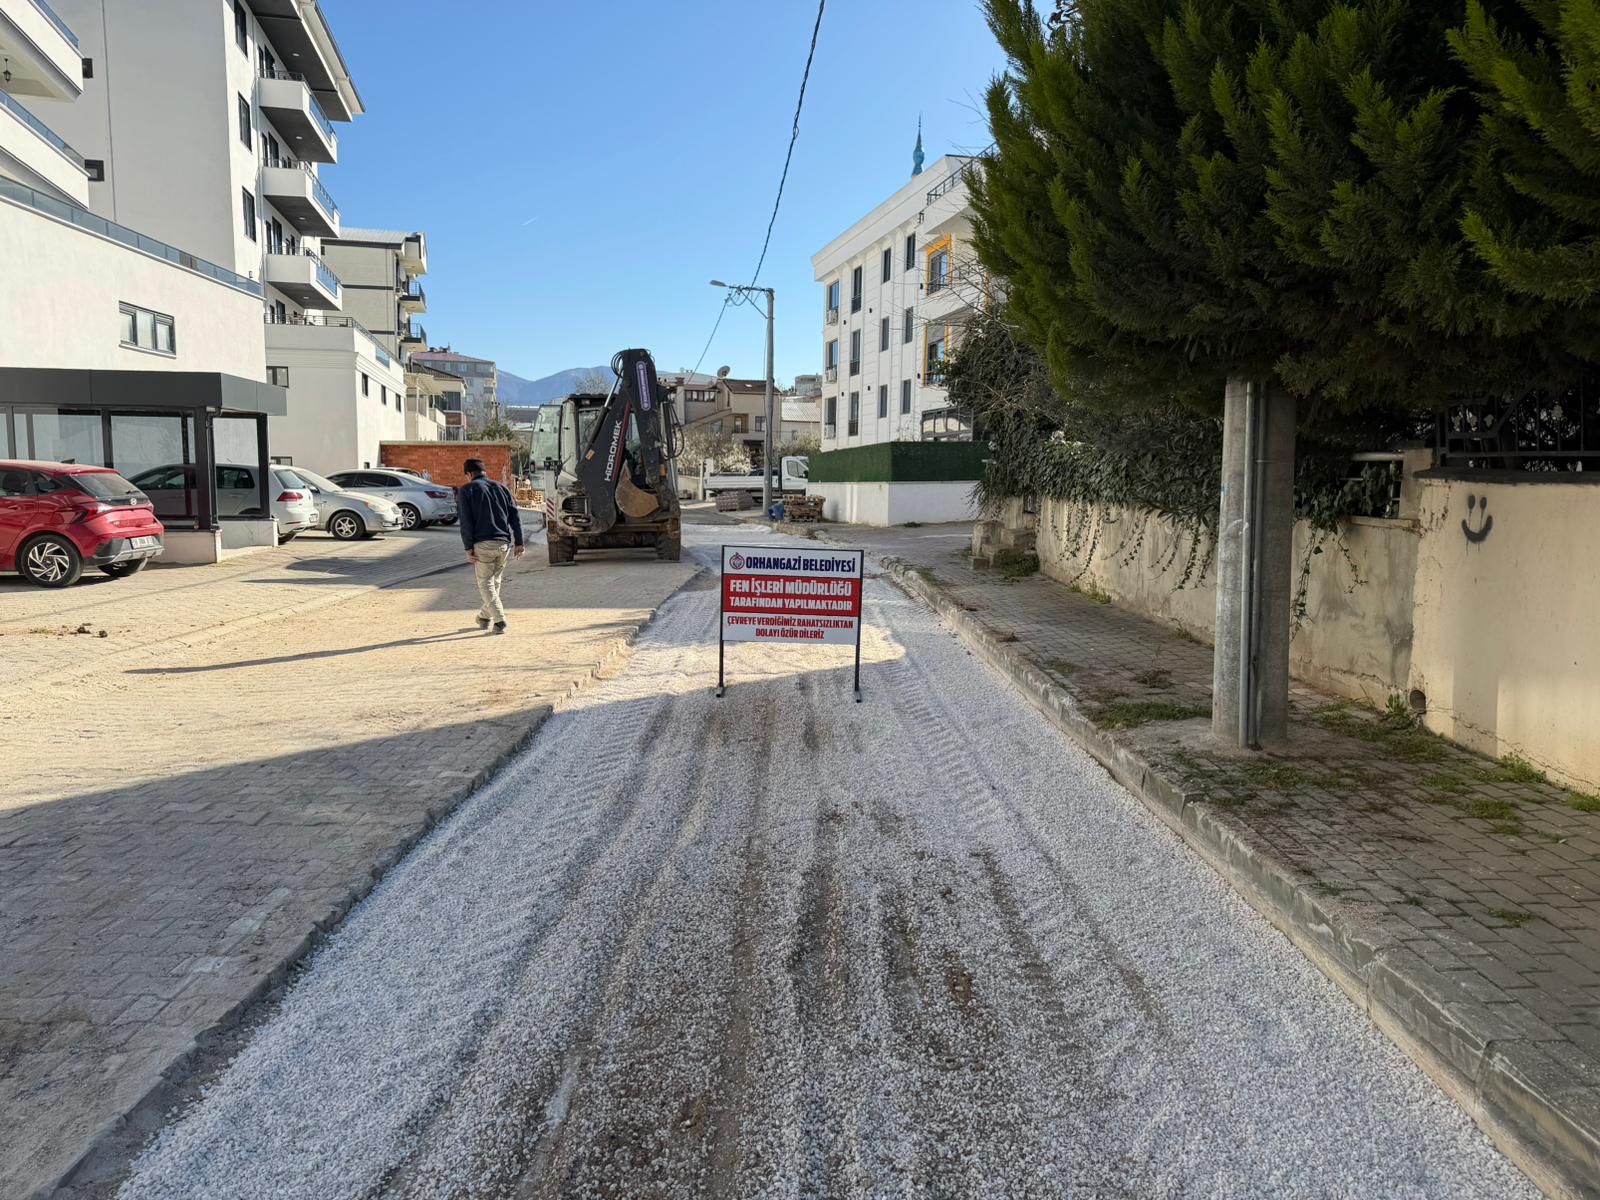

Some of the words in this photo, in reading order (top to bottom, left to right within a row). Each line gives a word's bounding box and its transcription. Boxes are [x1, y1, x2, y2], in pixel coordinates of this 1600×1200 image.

[746, 555, 802, 571] ORHANGAZİ
[803, 556, 856, 573] BELEDİYESİ
[729, 579, 749, 593] FEN
[751, 577, 784, 596] İŞLERİ
[785, 579, 852, 596] MÜDÜRLÜĞÜ
[729, 596, 783, 608] TARAFINDAN
[784, 598, 853, 611] YAPILMAKTADIR
[727, 615, 756, 626] ÇEVREYE
[757, 615, 796, 627] VERDİĞİMİZ
[797, 618, 853, 629] RAHATSIZLIKTAN
[755, 628, 780, 637] DOLAYI
[780, 628, 798, 638] ÖZÜR
[799, 628, 825, 639] DİLERİZ
